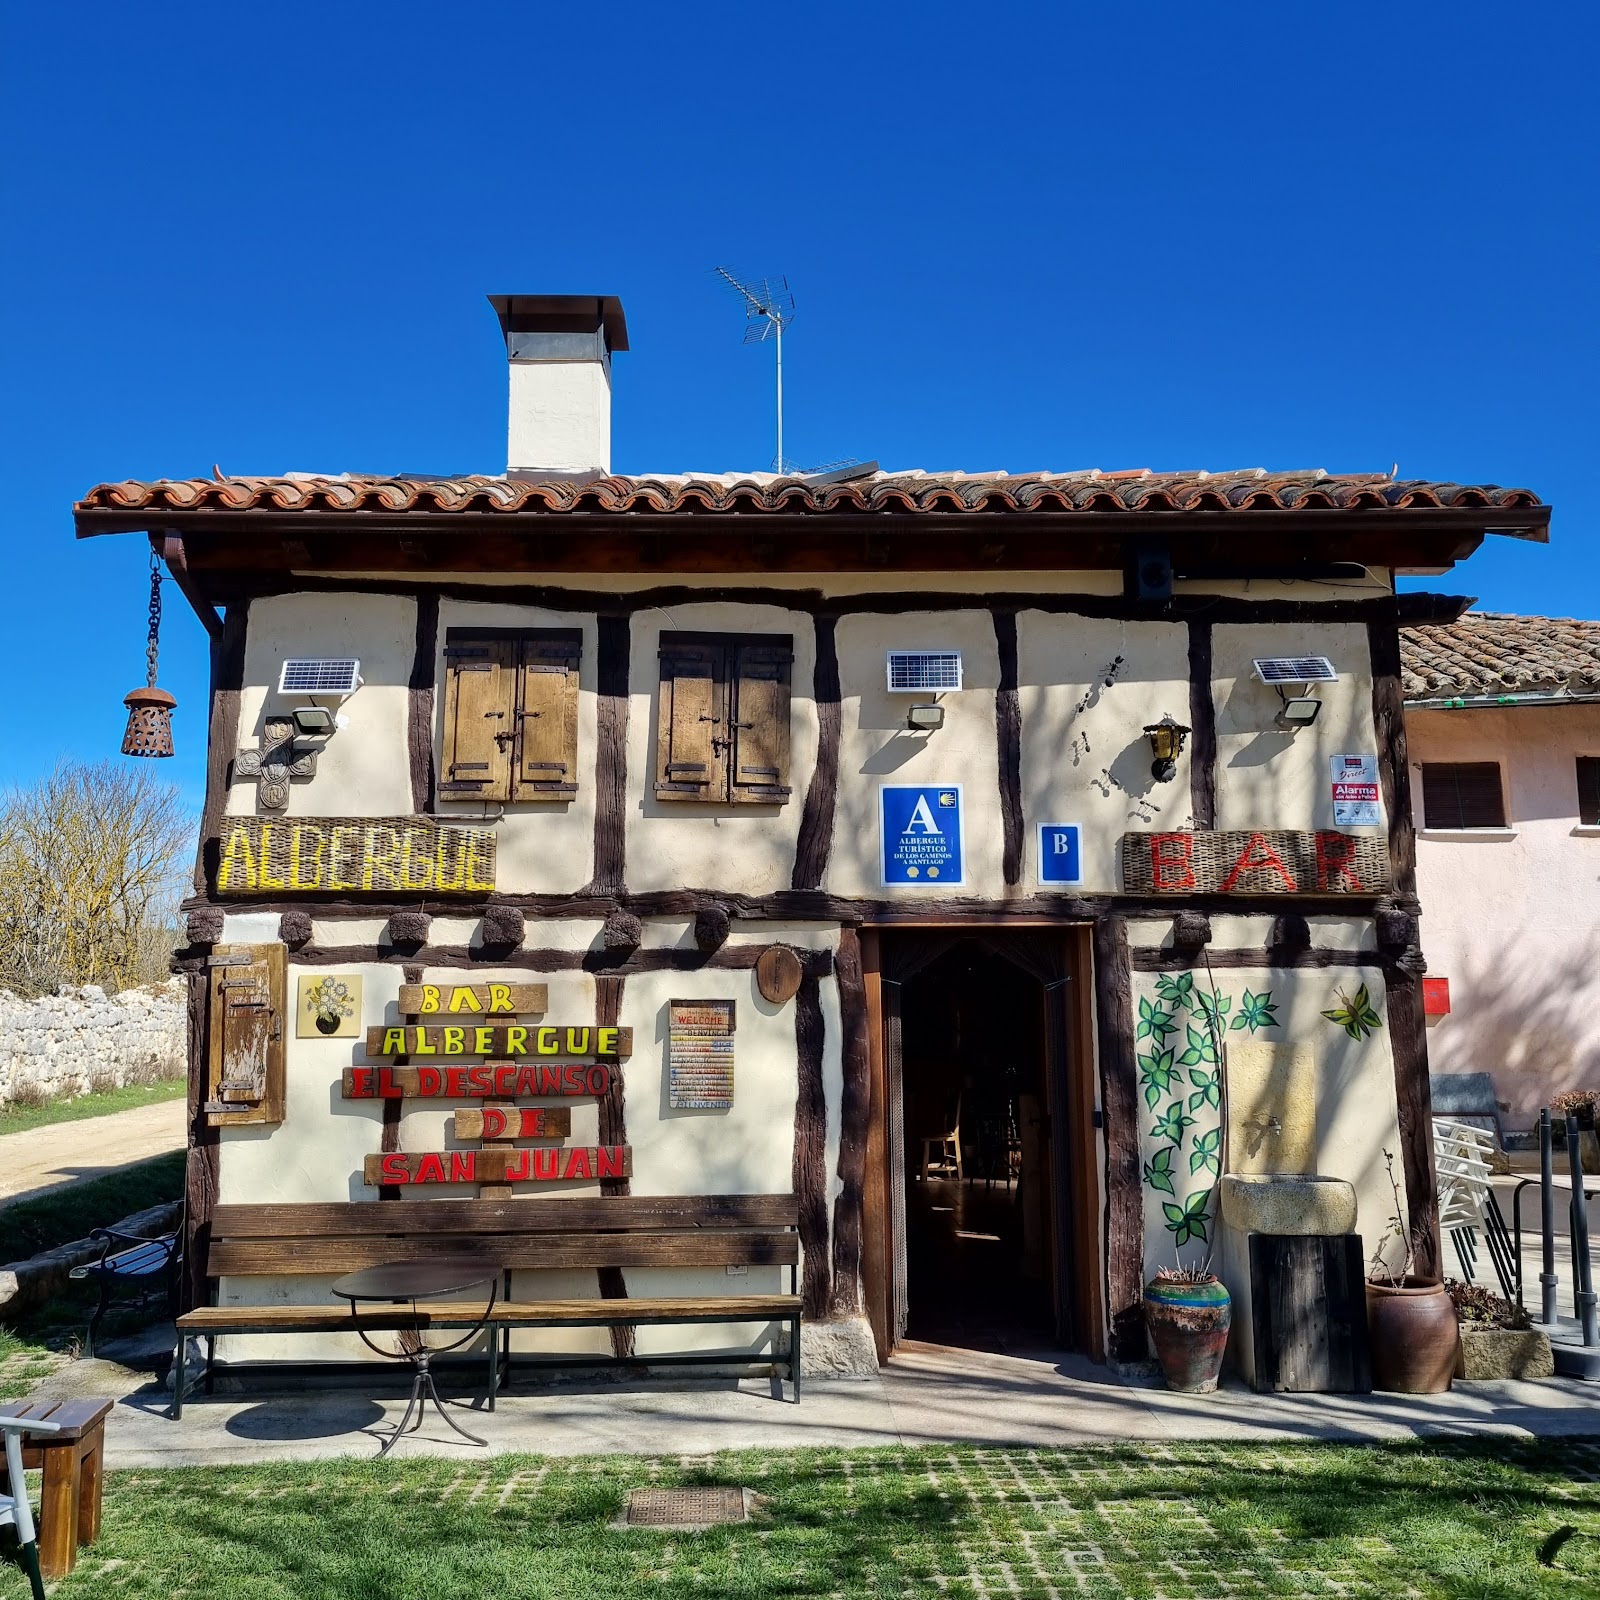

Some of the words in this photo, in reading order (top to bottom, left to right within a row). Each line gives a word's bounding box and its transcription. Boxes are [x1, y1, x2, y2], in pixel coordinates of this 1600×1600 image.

[1339, 767, 1369, 780] Direct
[1336, 785, 1376, 794] Alarma
[902, 794, 943, 834] A
[899, 837, 946, 845] ALBERGUE
[899, 844, 947, 853] TURÍSTICO
[1053, 833, 1069, 854] B
[217, 825, 495, 890] ALBERGUE
[1150, 832, 1365, 891] BAR
[420, 984, 516, 1013] BAR
[678, 1016, 723, 1025] WELCOME
[382, 1027, 619, 1054] ALBERGUE
[352, 1066, 403, 1098] EL
[416, 1065, 609, 1097] DESCANSO
[481, 1108, 545, 1137] DE
[381, 1152, 475, 1184] SAN
[505, 1146, 624, 1181] JUAN
